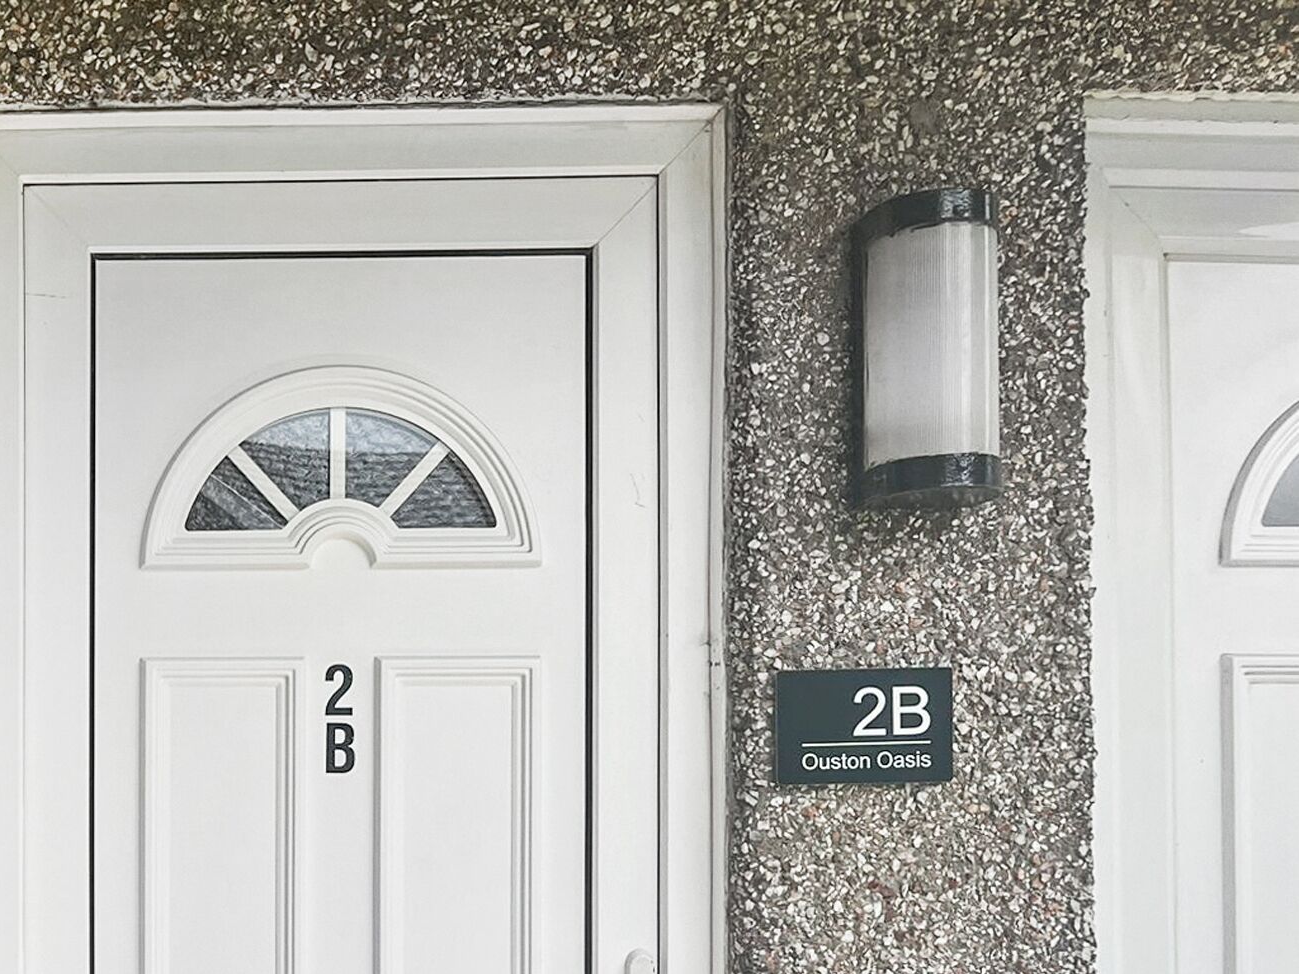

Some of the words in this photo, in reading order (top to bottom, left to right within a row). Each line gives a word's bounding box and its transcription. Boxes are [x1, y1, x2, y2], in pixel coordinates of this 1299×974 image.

[853, 686, 931, 736] 2B
[802, 753, 870, 770] Ouston
[877, 751, 931, 768] Oasis
